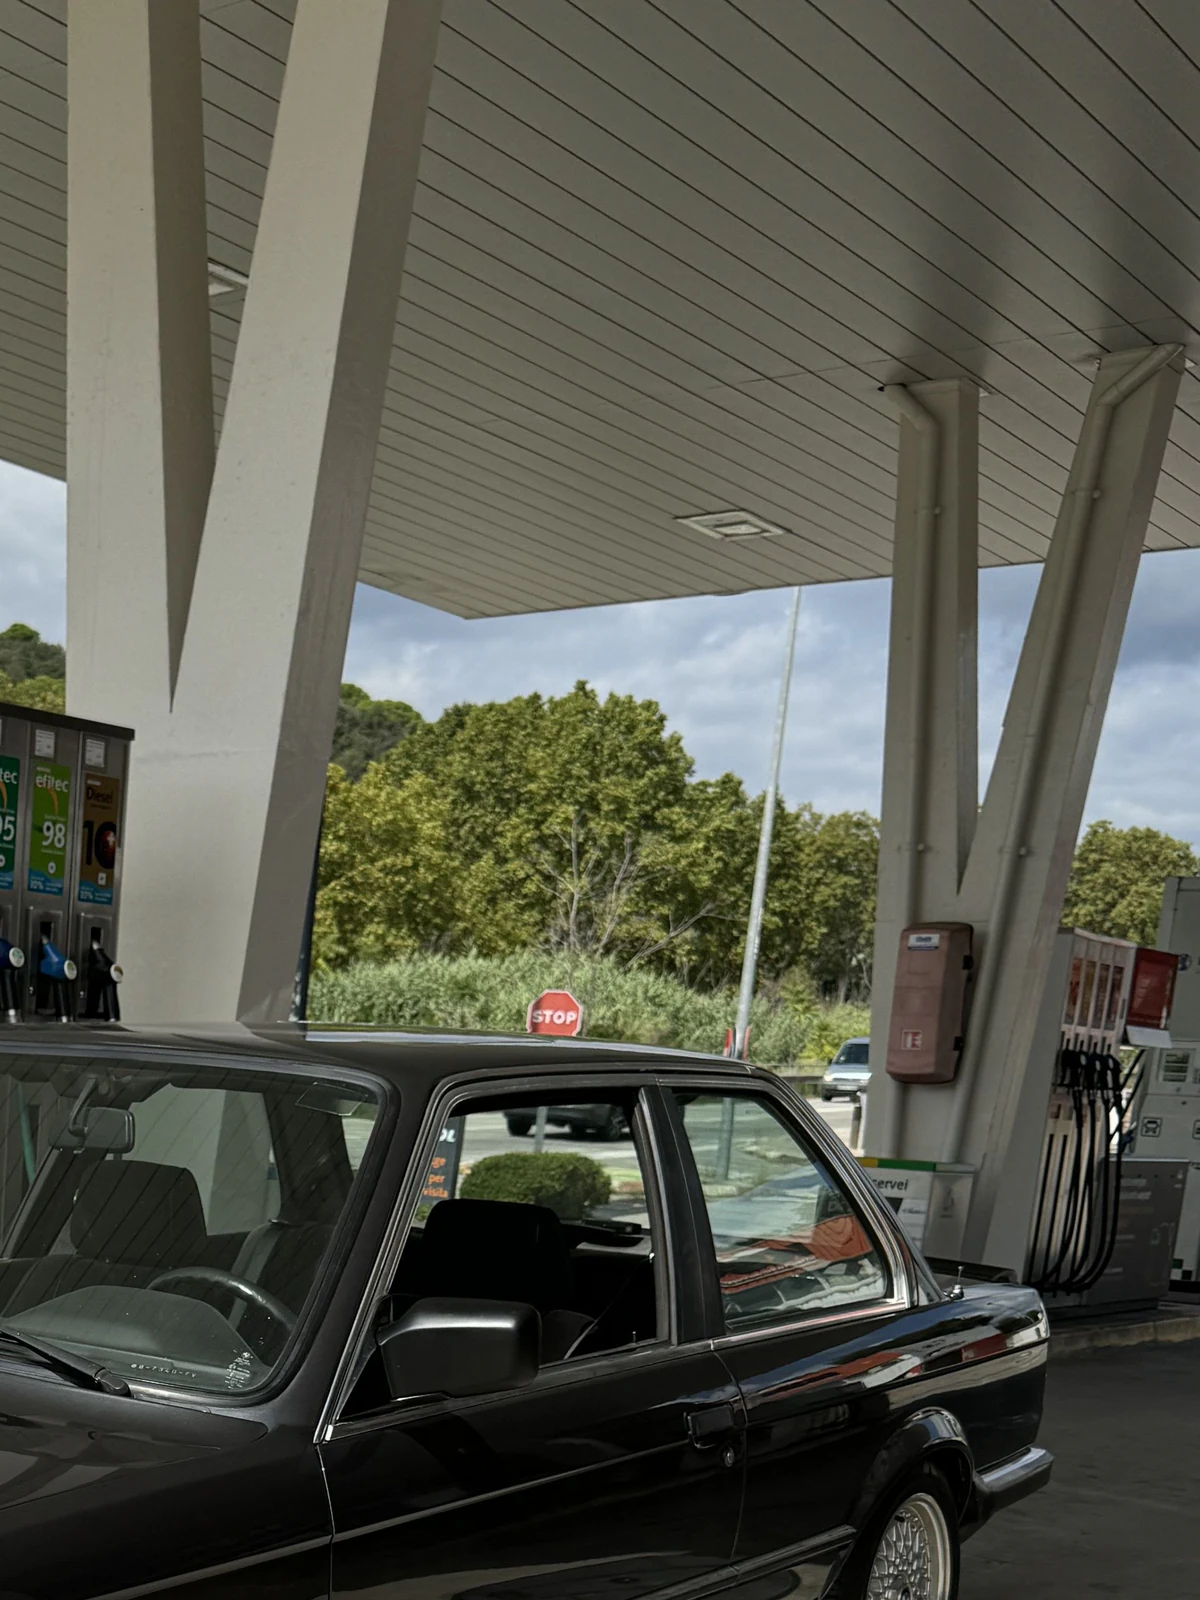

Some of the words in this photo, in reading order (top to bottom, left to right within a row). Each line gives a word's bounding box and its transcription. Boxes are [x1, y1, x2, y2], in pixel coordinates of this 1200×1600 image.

[35, 774, 69, 793] efitec
[86, 786, 113, 805] Diesel
[42, 821, 66, 849] 98
[532, 1010, 578, 1025] STOP
